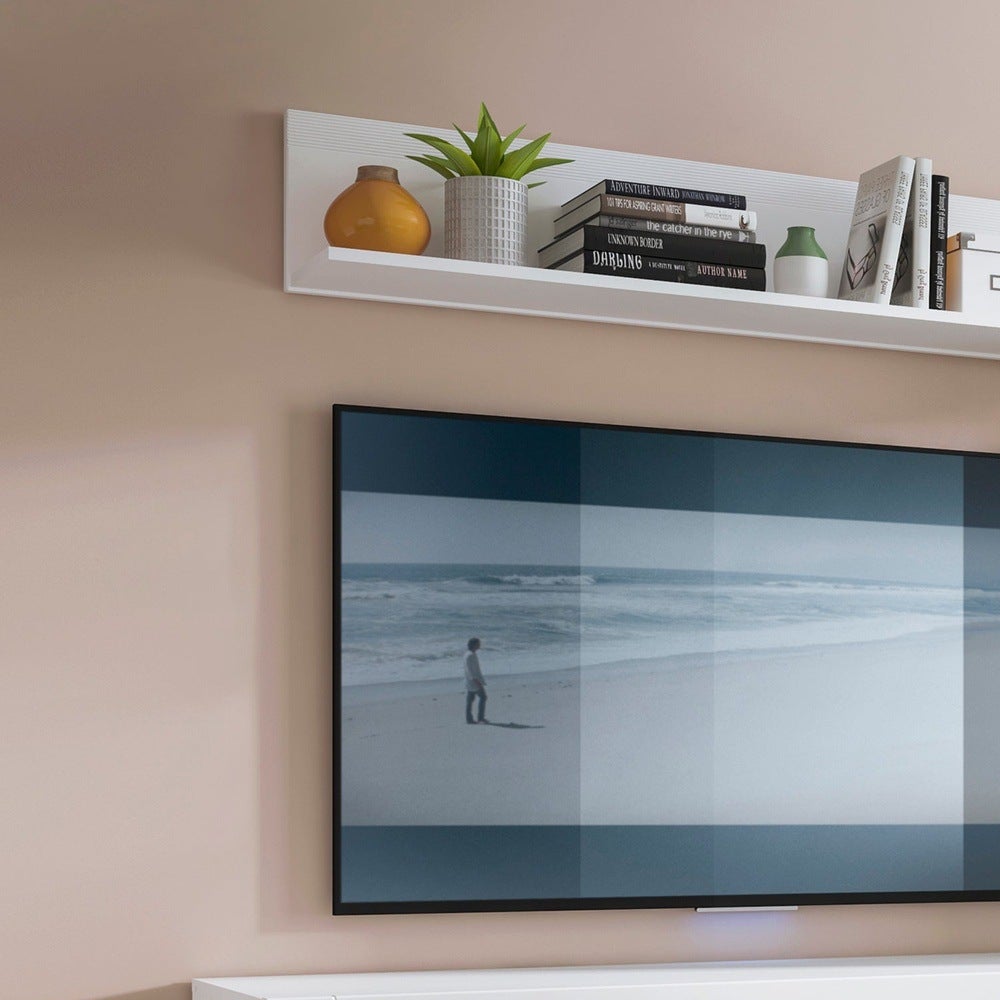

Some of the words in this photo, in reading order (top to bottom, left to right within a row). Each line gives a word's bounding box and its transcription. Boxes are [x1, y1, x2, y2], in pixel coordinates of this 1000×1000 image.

[610, 180, 651, 196] ADVENTURE
[652, 185, 680, 199] INWARD
[646, 220, 660, 232] the
[662, 223, 692, 235] catcher
[694, 226, 702, 236] in
[704, 227, 717, 238] the
[719, 231, 733, 240] rye
[607, 233, 639, 247] UNKNOWN
[640, 236, 664, 250] BORDER
[592, 250, 643, 271] DARLING
[697, 265, 726, 278] AUTHOR
[727, 267, 748, 280] NAME
